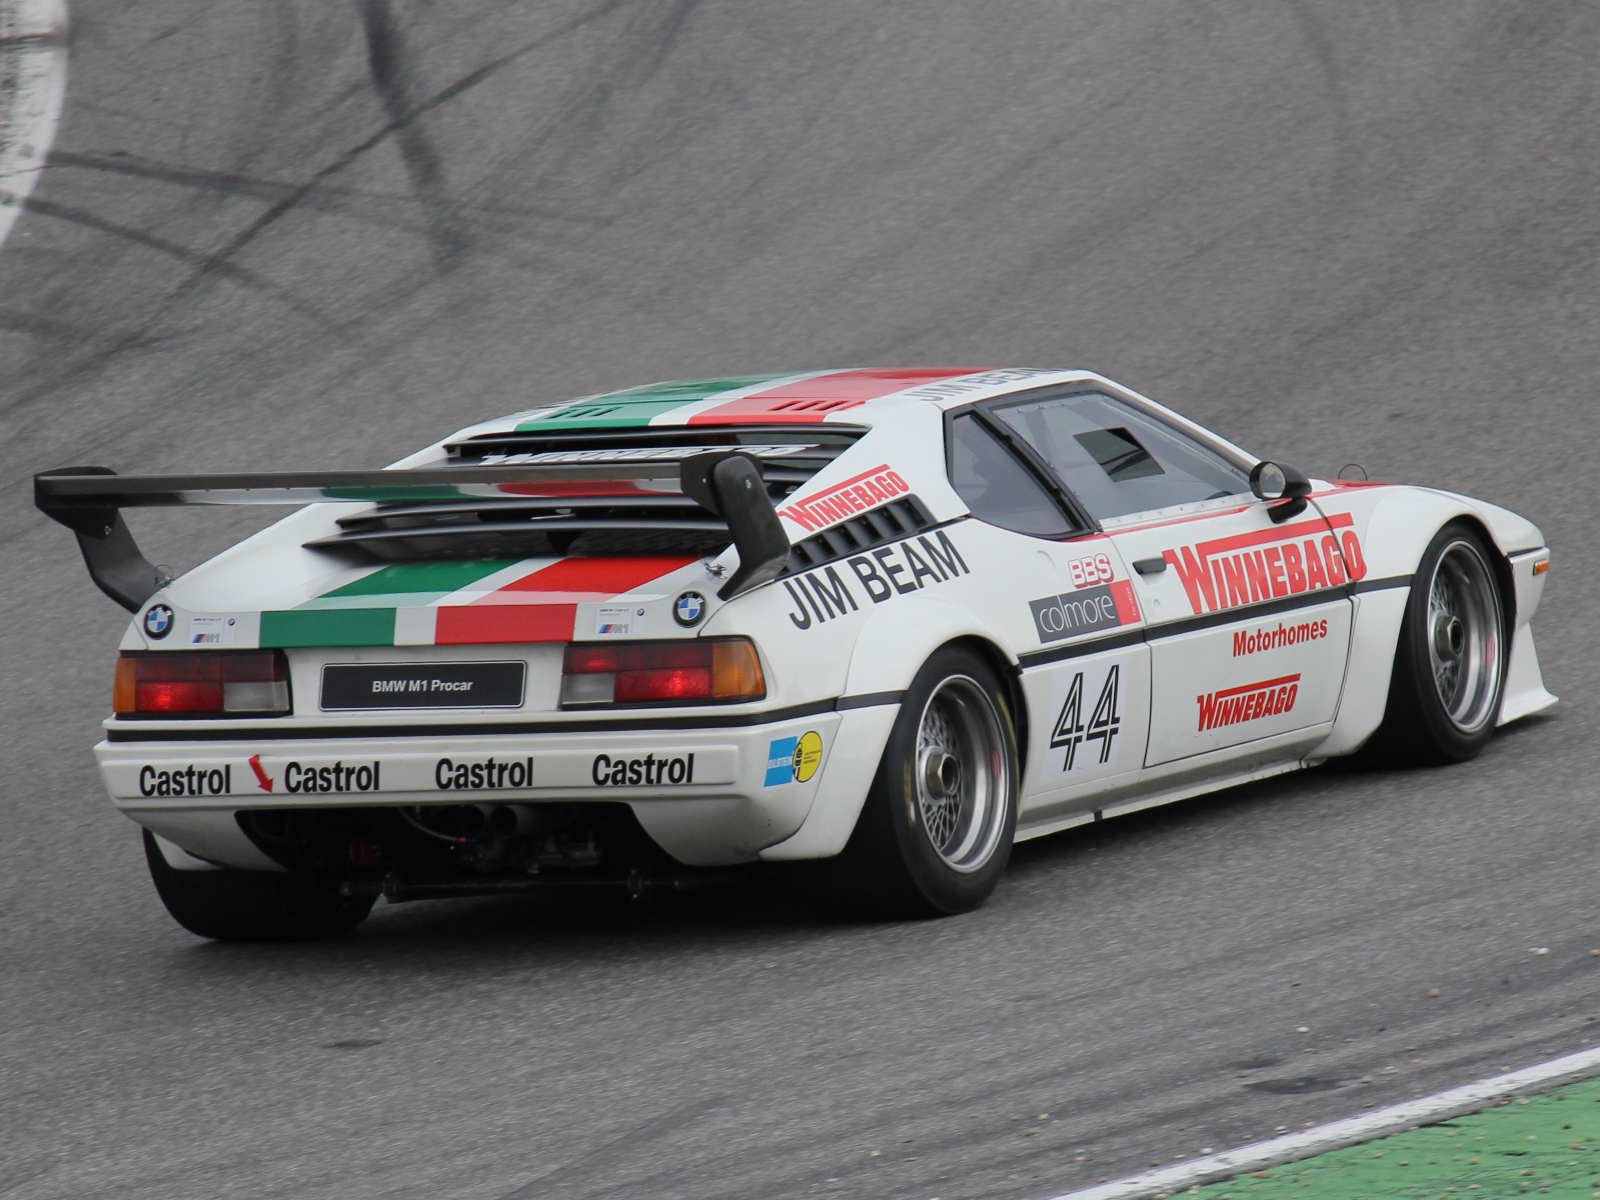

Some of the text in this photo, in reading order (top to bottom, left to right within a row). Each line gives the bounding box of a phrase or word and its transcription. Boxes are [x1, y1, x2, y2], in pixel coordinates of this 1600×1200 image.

[903, 381, 982, 402] JIM
[777, 464, 910, 533] WINNEBAGO
[783, 530, 971, 631] JIM BEAM
[1068, 553, 1115, 589] BBS
[1161, 512, 1368, 615] WINNEBAGO
[1040, 595, 1116, 633] colmore
[1233, 619, 1328, 657] Motorhomes
[372, 679, 473, 693] BMW M1 Procar
[1196, 673, 1301, 732] WINNEBAGO
[1050, 664, 1121, 772] 44
[139, 764, 232, 797] Castrol
[284, 761, 380, 794] Castrol
[435, 757, 534, 790] Castrol
[592, 753, 695, 787] Castrol
